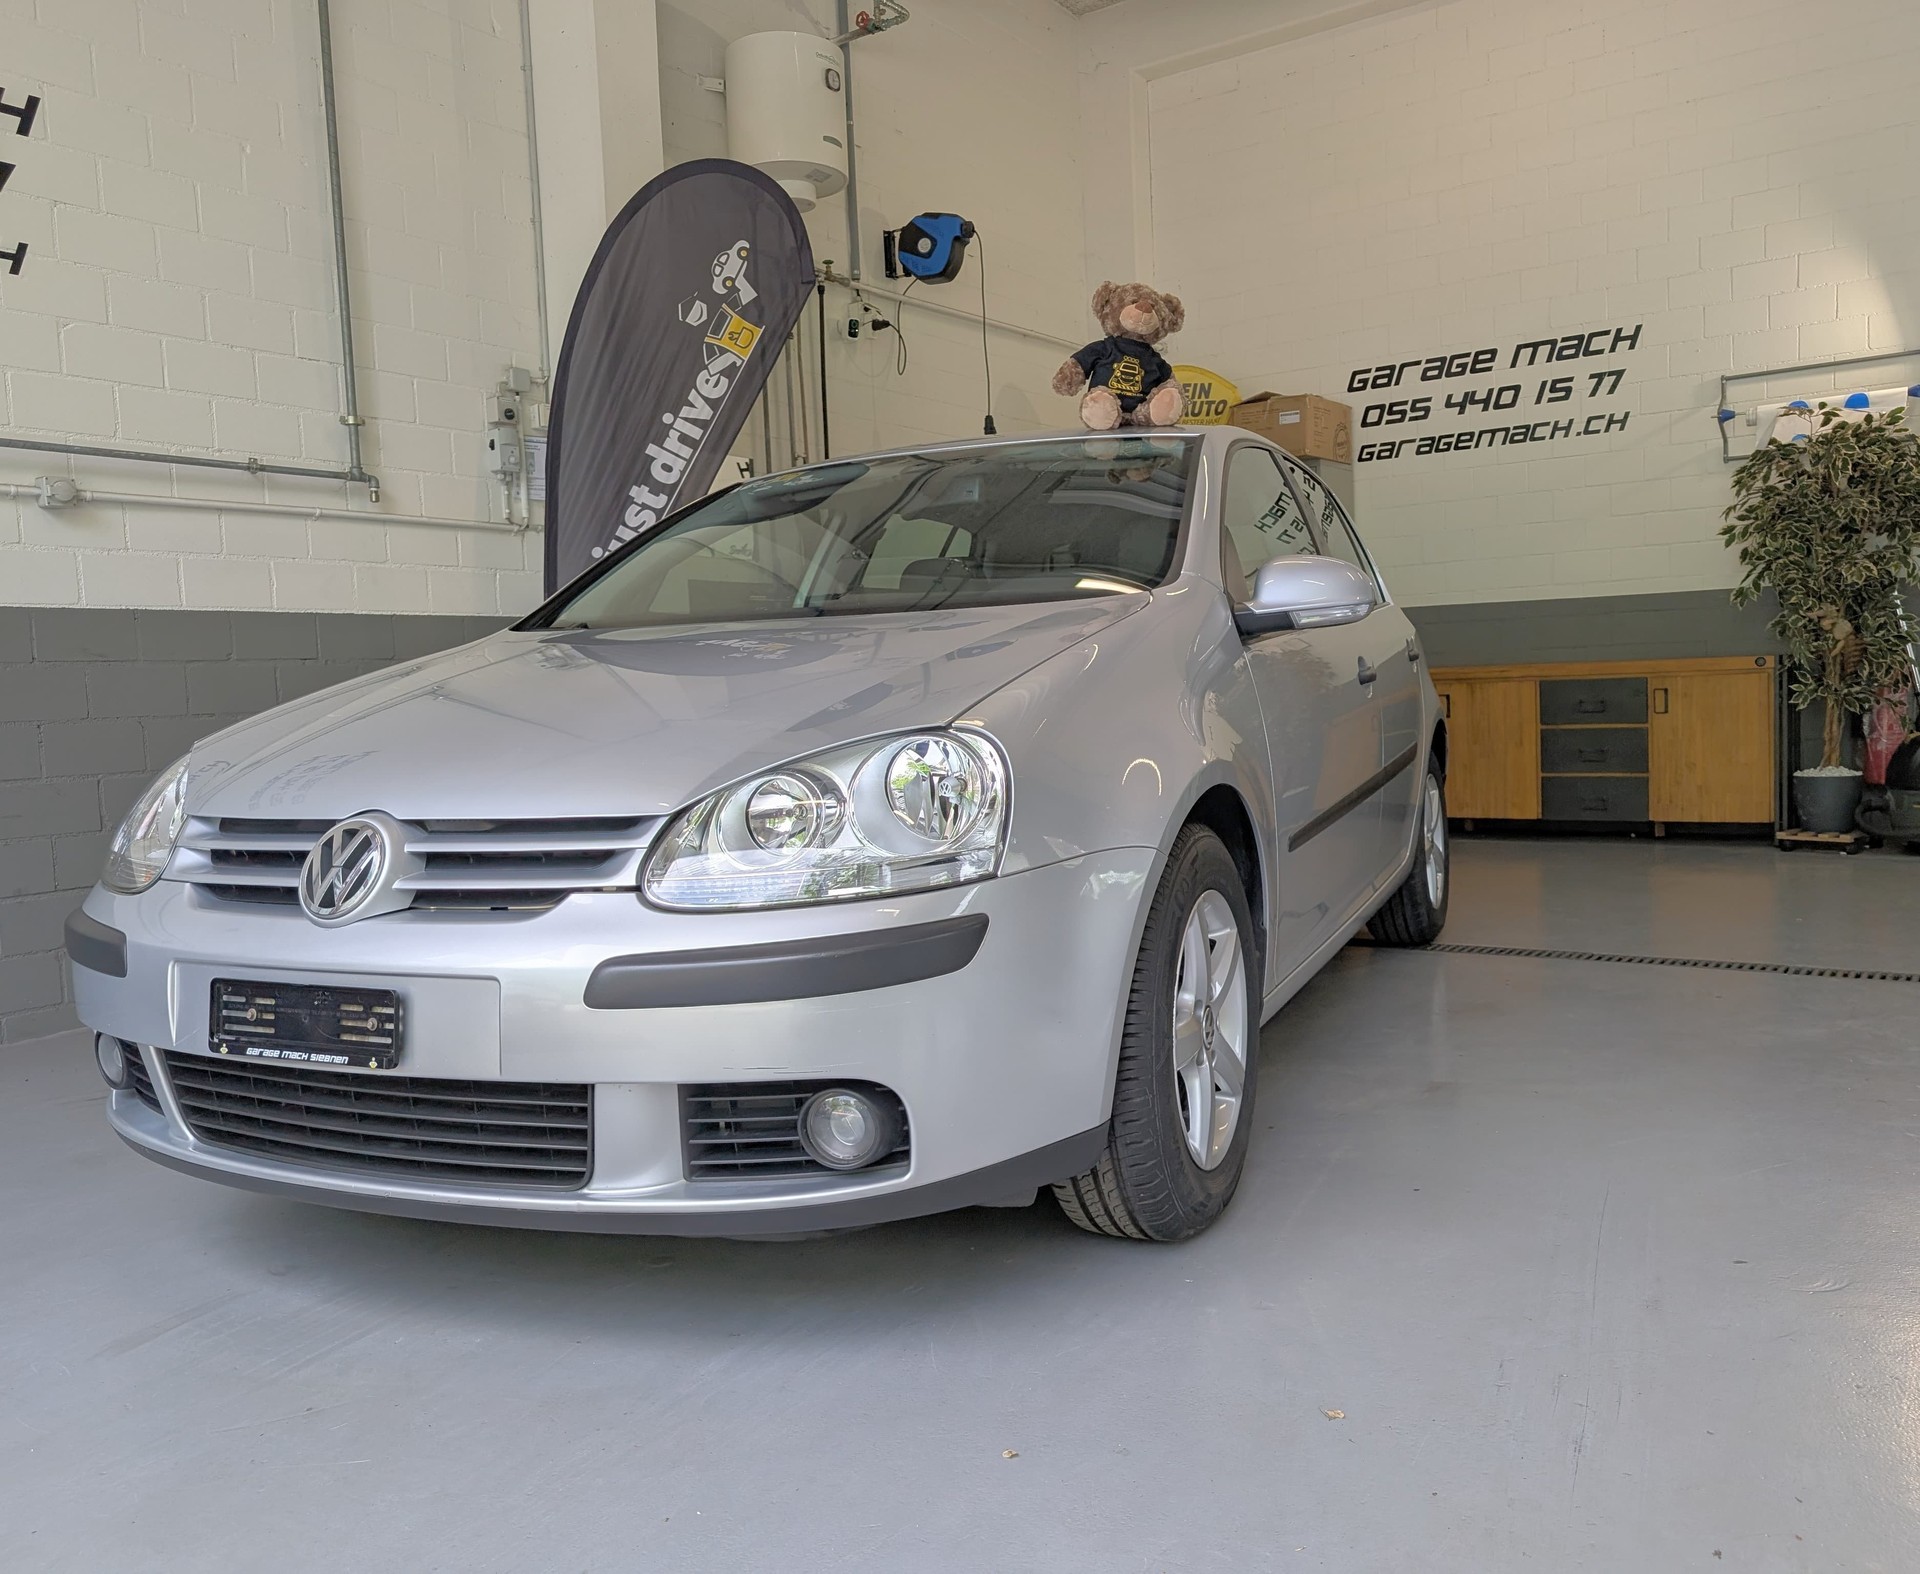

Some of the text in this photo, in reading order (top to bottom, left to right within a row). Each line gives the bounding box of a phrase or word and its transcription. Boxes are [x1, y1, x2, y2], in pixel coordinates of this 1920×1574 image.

[1360, 397, 1432, 428] 055
[1445, 384, 1522, 415] 440
[1587, 368, 1627, 398] 77
